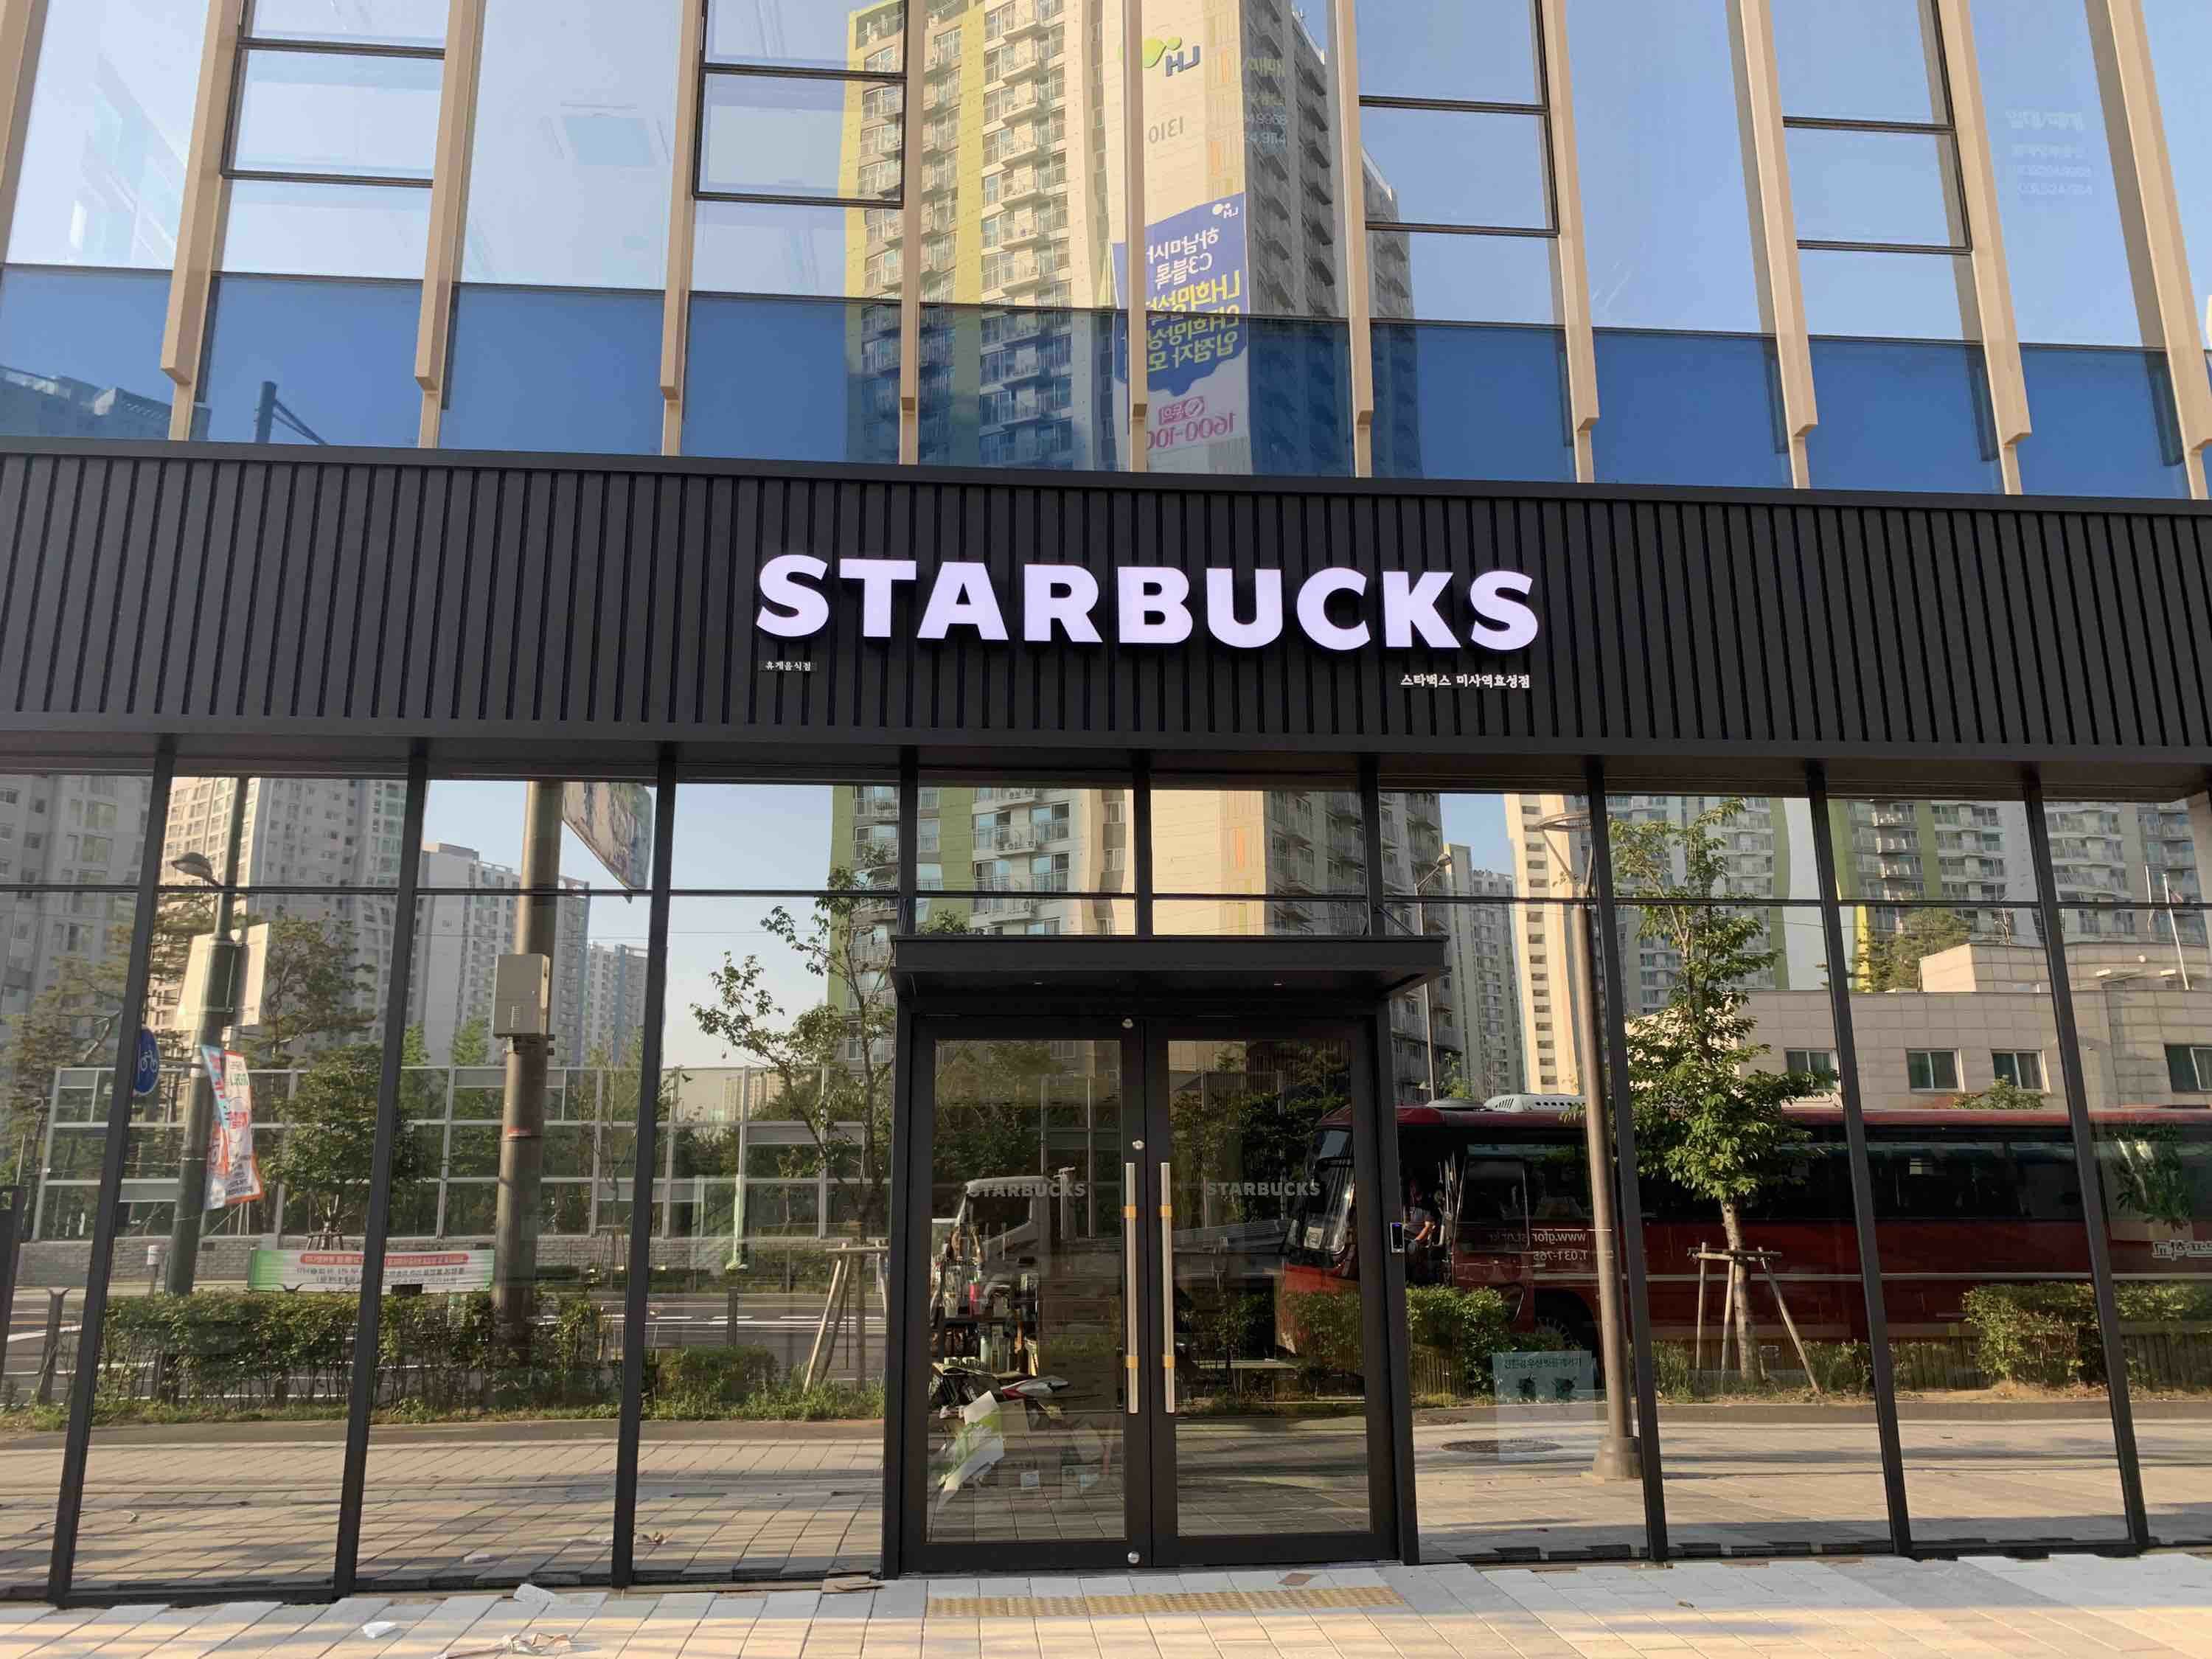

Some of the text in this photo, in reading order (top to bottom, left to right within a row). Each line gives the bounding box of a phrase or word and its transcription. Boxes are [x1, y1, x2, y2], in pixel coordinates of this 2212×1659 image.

[756, 554, 1540, 653] STARBUCKS
[765, 661, 811, 672] 휴게음식점
[1400, 673, 1531, 689] 스타벅스 미사역효성점
[967, 1183, 1086, 1197] STARBUCKS
[1206, 1182, 1321, 1197] STARBUCKS
